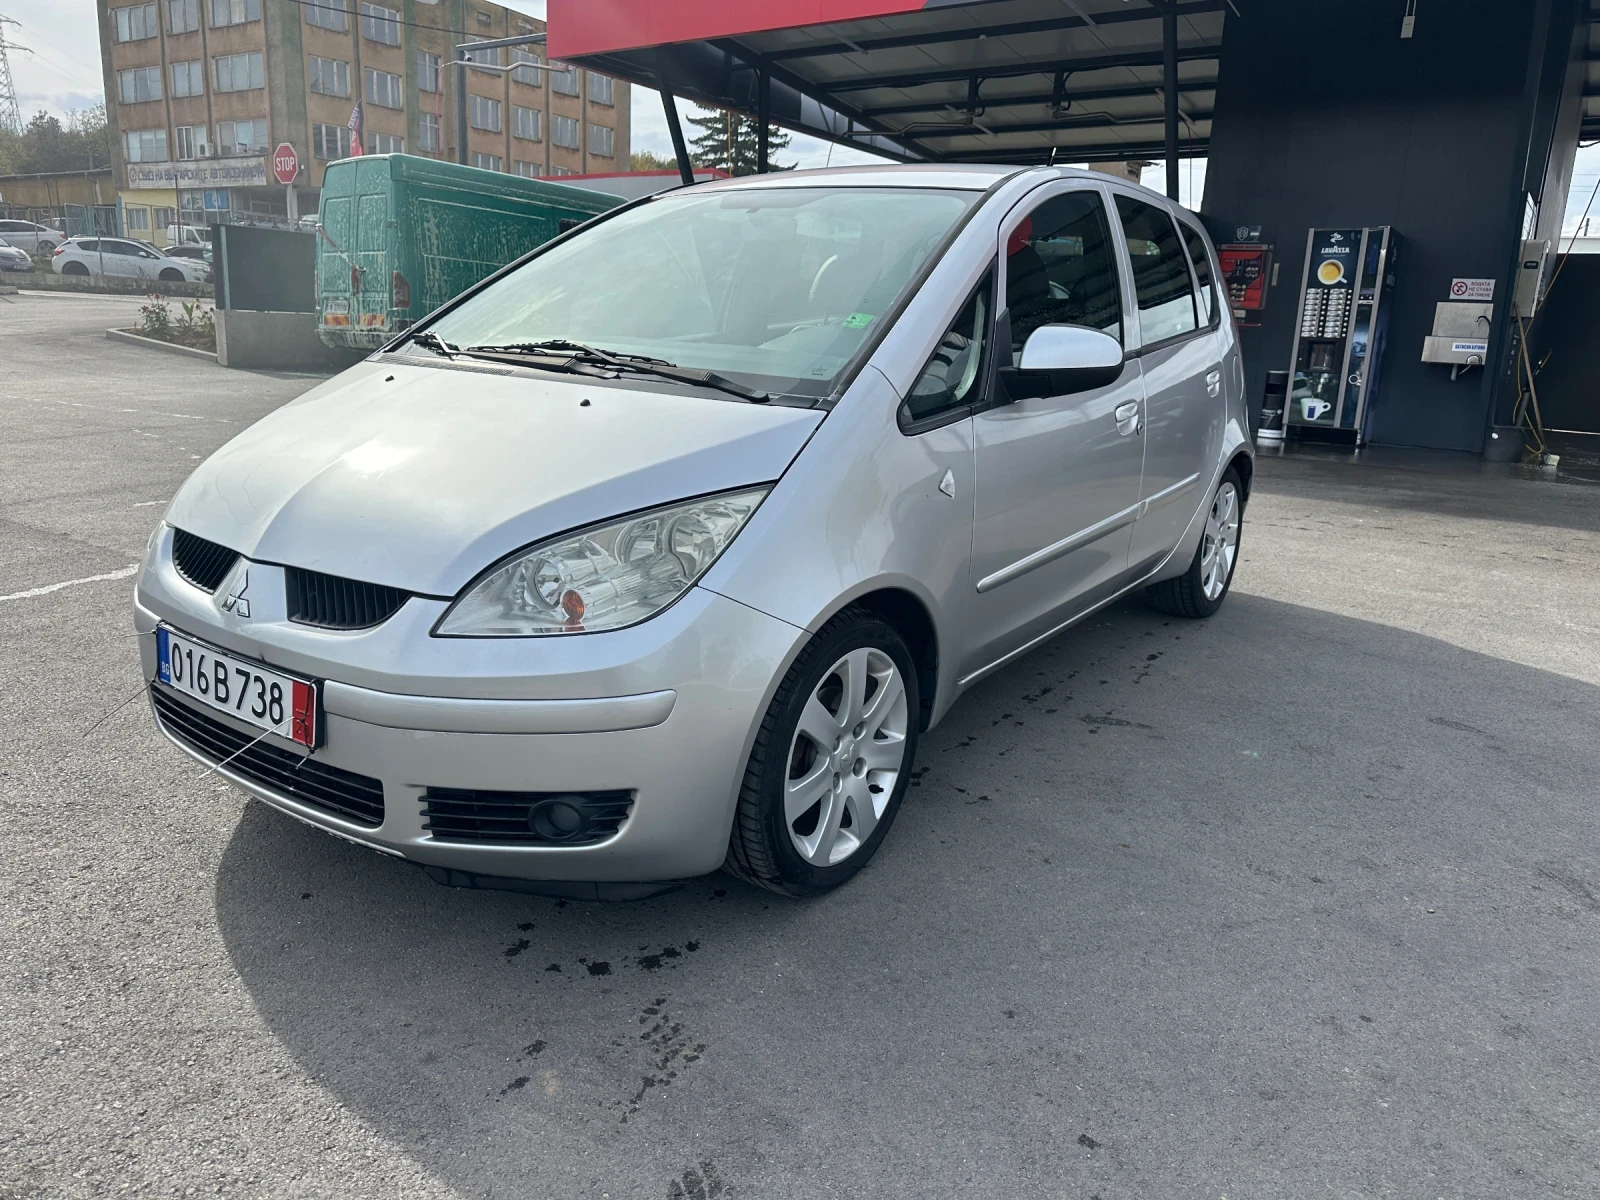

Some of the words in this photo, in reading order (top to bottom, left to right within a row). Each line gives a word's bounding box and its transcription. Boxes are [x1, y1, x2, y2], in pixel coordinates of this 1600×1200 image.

[276, 157, 295, 171] STOP
[156, 170, 164, 181] НА
[1321, 245, 1350, 254] LAVAZZA
[161, 661, 170, 675] BG
[172, 642, 284, 725] 016B738
